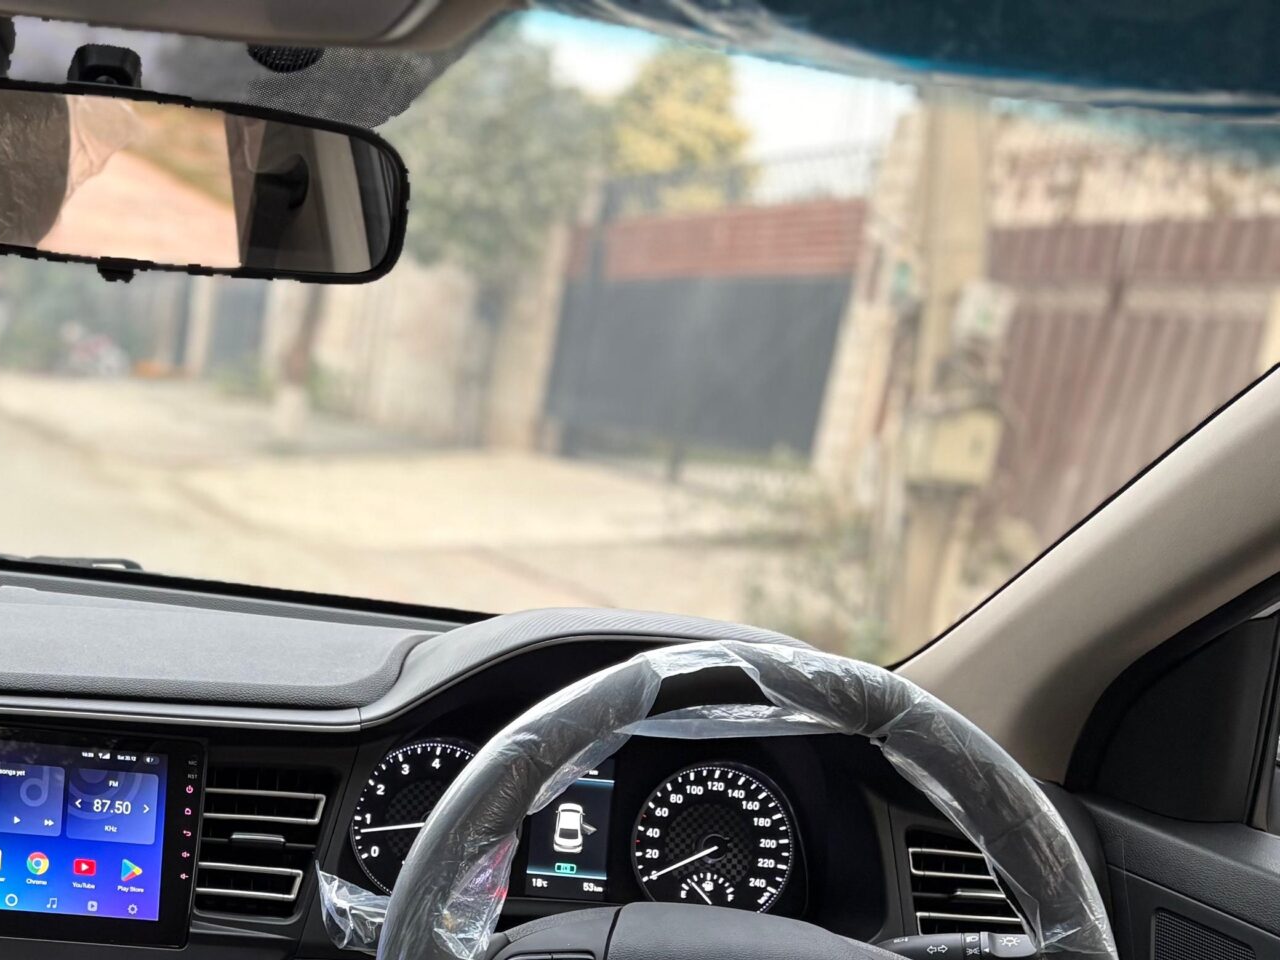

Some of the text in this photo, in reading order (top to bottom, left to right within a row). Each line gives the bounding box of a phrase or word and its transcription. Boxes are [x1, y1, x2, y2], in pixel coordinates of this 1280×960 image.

[431, 758, 441, 770] 4
[401, 764, 410, 775] 3
[376, 784, 386, 796] 2
[685, 785, 704, 795] 100
[707, 781, 725, 791] 120
[669, 794, 684, 804] 80
[727, 789, 745, 799] 140
[93, 799, 132, 815] 87.50
[742, 801, 760, 811] 160
[655, 807, 669, 817] 60
[365, 813, 372, 825] 1
[753, 817, 771, 827] 180
[104, 825, 118, 833] KHz
[646, 828, 660, 838] 40
[759, 838, 777, 849] 200
[370, 846, 380, 858] 0
[645, 848, 659, 859] 20
[757, 858, 775, 868] 220
[25, 878, 48, 886] Chrome
[72, 881, 96, 890] YouTube
[748, 877, 767, 888] 240
[117, 885, 145, 894] Play Store
